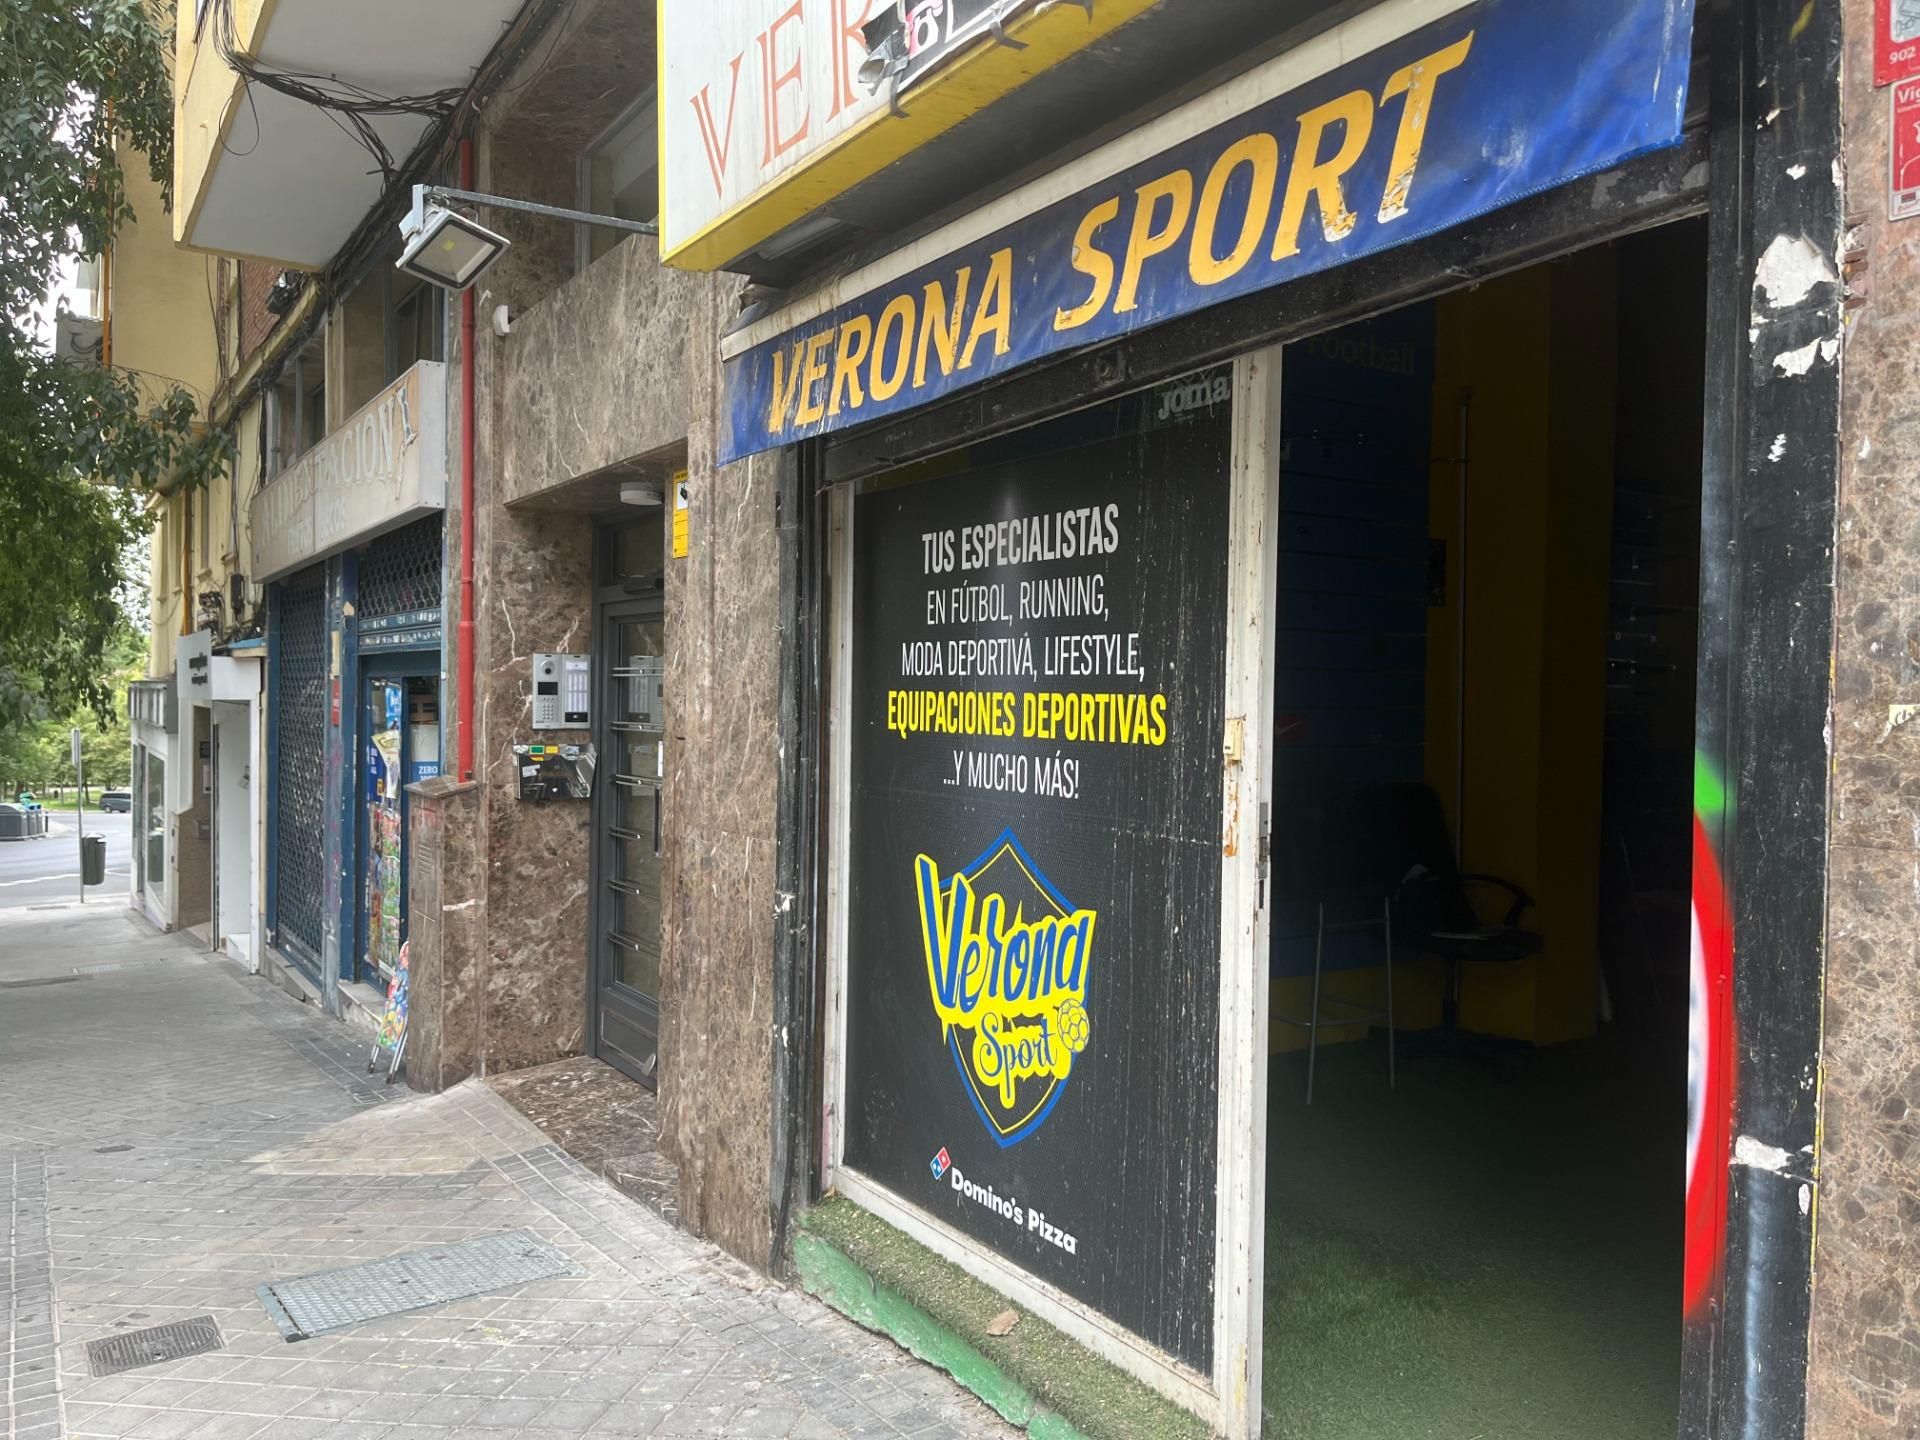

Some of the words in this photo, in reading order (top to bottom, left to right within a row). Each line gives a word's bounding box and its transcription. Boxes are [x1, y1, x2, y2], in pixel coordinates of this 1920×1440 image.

[1889, 47, 1916, 64] 902
[768, 247, 1012, 433] VERONA
[1055, 30, 1474, 331] SPORT
[922, 529, 955, 575] TUS
[961, 503, 1119, 570] ESPECIALISTAS
[927, 590, 946, 625] EN
[951, 580, 1013, 627] FÚTBOL,
[1019, 574, 1109, 621] RUNNING,
[901, 641, 943, 677] MODA
[1044, 633, 1145, 682] LIFESTYLE,
[887, 690, 1016, 739] EQUIPACIONES
[1022, 692, 1167, 746] DEPORTIVAS
[418, 765, 438, 775] ZERO
[968, 754, 1028, 793] MUCHO
[1034, 750, 1080, 799] MÁS!
[916, 854, 1096, 1014] Verona
[979, 1012, 1057, 1099] Sport
[951, 1167, 1024, 1226] Domino's
[1028, 1207, 1077, 1255] Pizza
